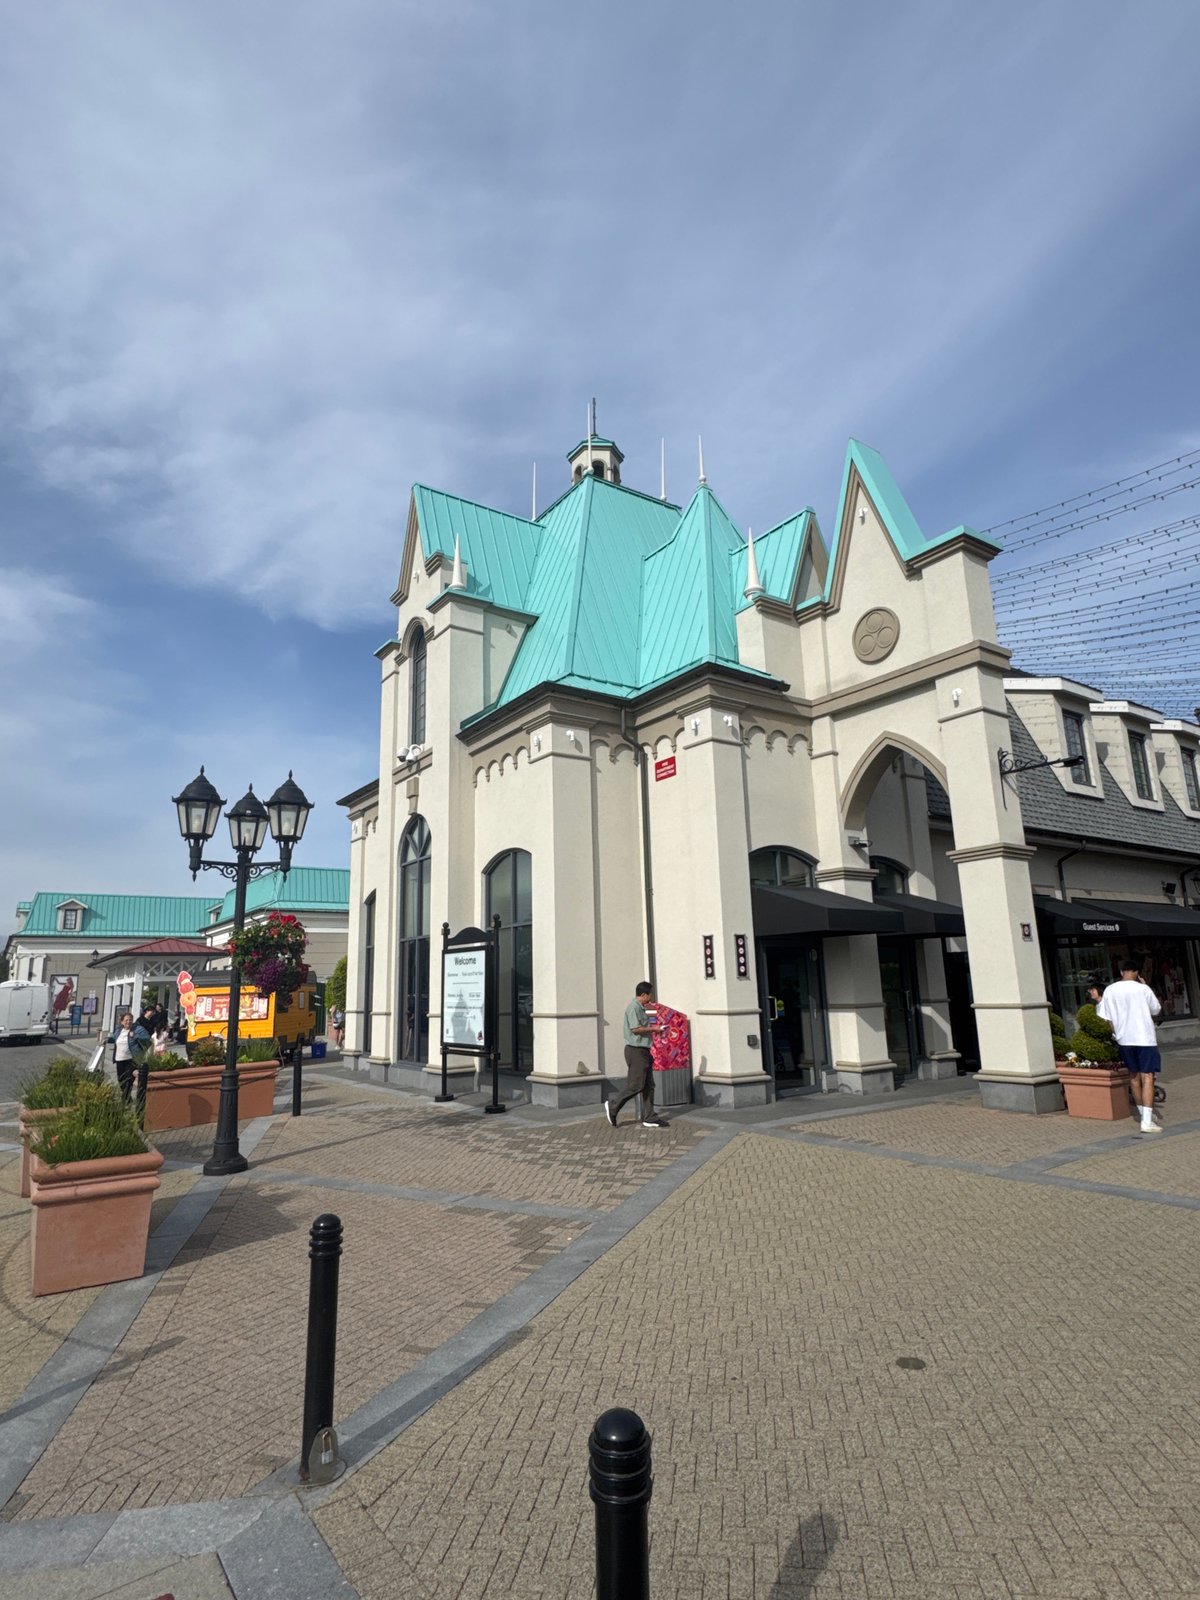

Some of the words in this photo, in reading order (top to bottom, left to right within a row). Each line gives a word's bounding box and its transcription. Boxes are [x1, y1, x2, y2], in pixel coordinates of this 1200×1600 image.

[1083, 922, 1096, 931] Guest
[1097, 923, 1115, 932] Services
[454, 957, 476, 966] Welcome
